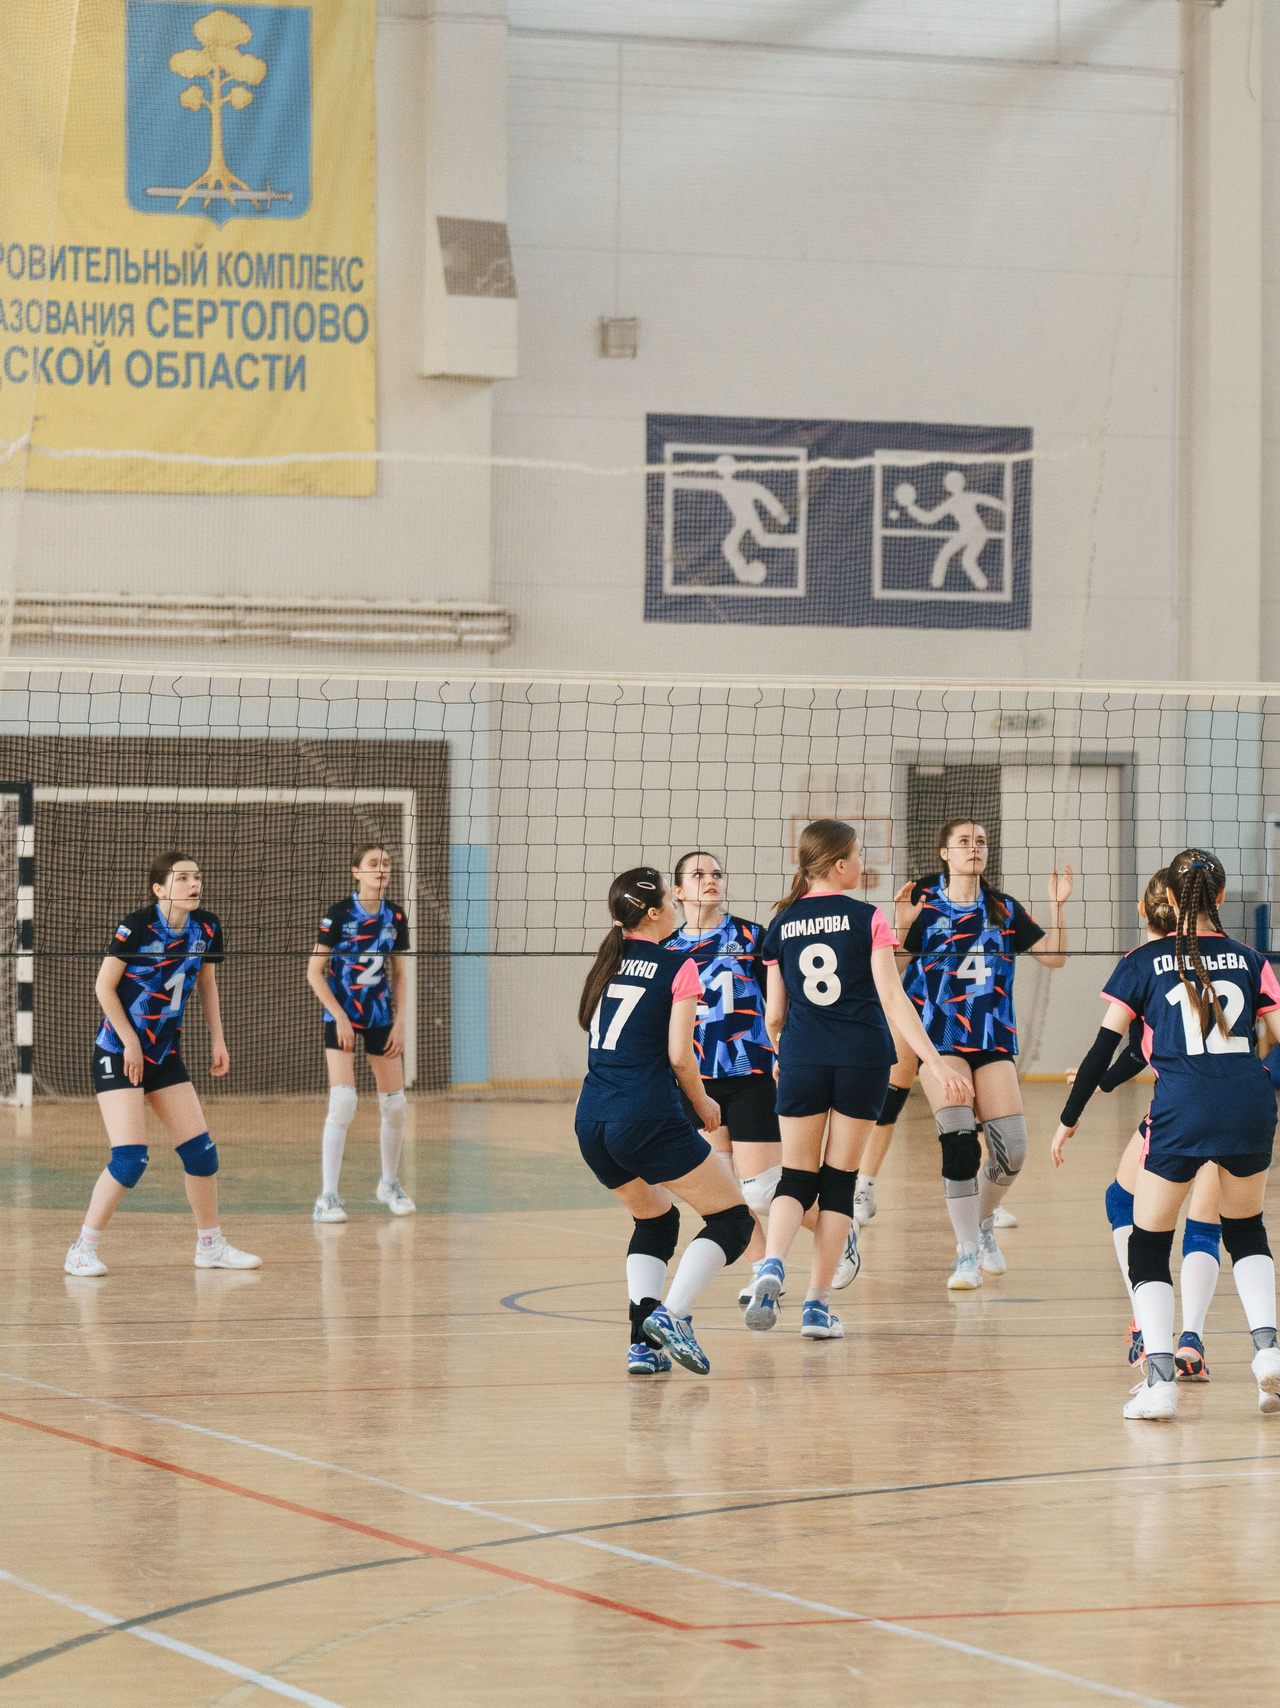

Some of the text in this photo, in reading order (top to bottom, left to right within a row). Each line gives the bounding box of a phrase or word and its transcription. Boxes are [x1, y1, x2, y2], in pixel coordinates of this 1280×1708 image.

[217, 251, 364, 293] КОМПЛЕКС
[146, 297, 369, 344] СЕРТОЛОВО
[125, 349, 307, 391] ОБЛАСТИ
[781, 915, 850, 940] КОМАРОВА
[357, 950, 384, 985] 2
[615, 959, 659, 980] УКНО
[799, 943, 841, 1006] 8
[957, 945, 992, 985] 4
[164, 973, 186, 1012] 1
[1165, 980, 1250, 1055] 12
[99, 1056, 113, 1074] 1
